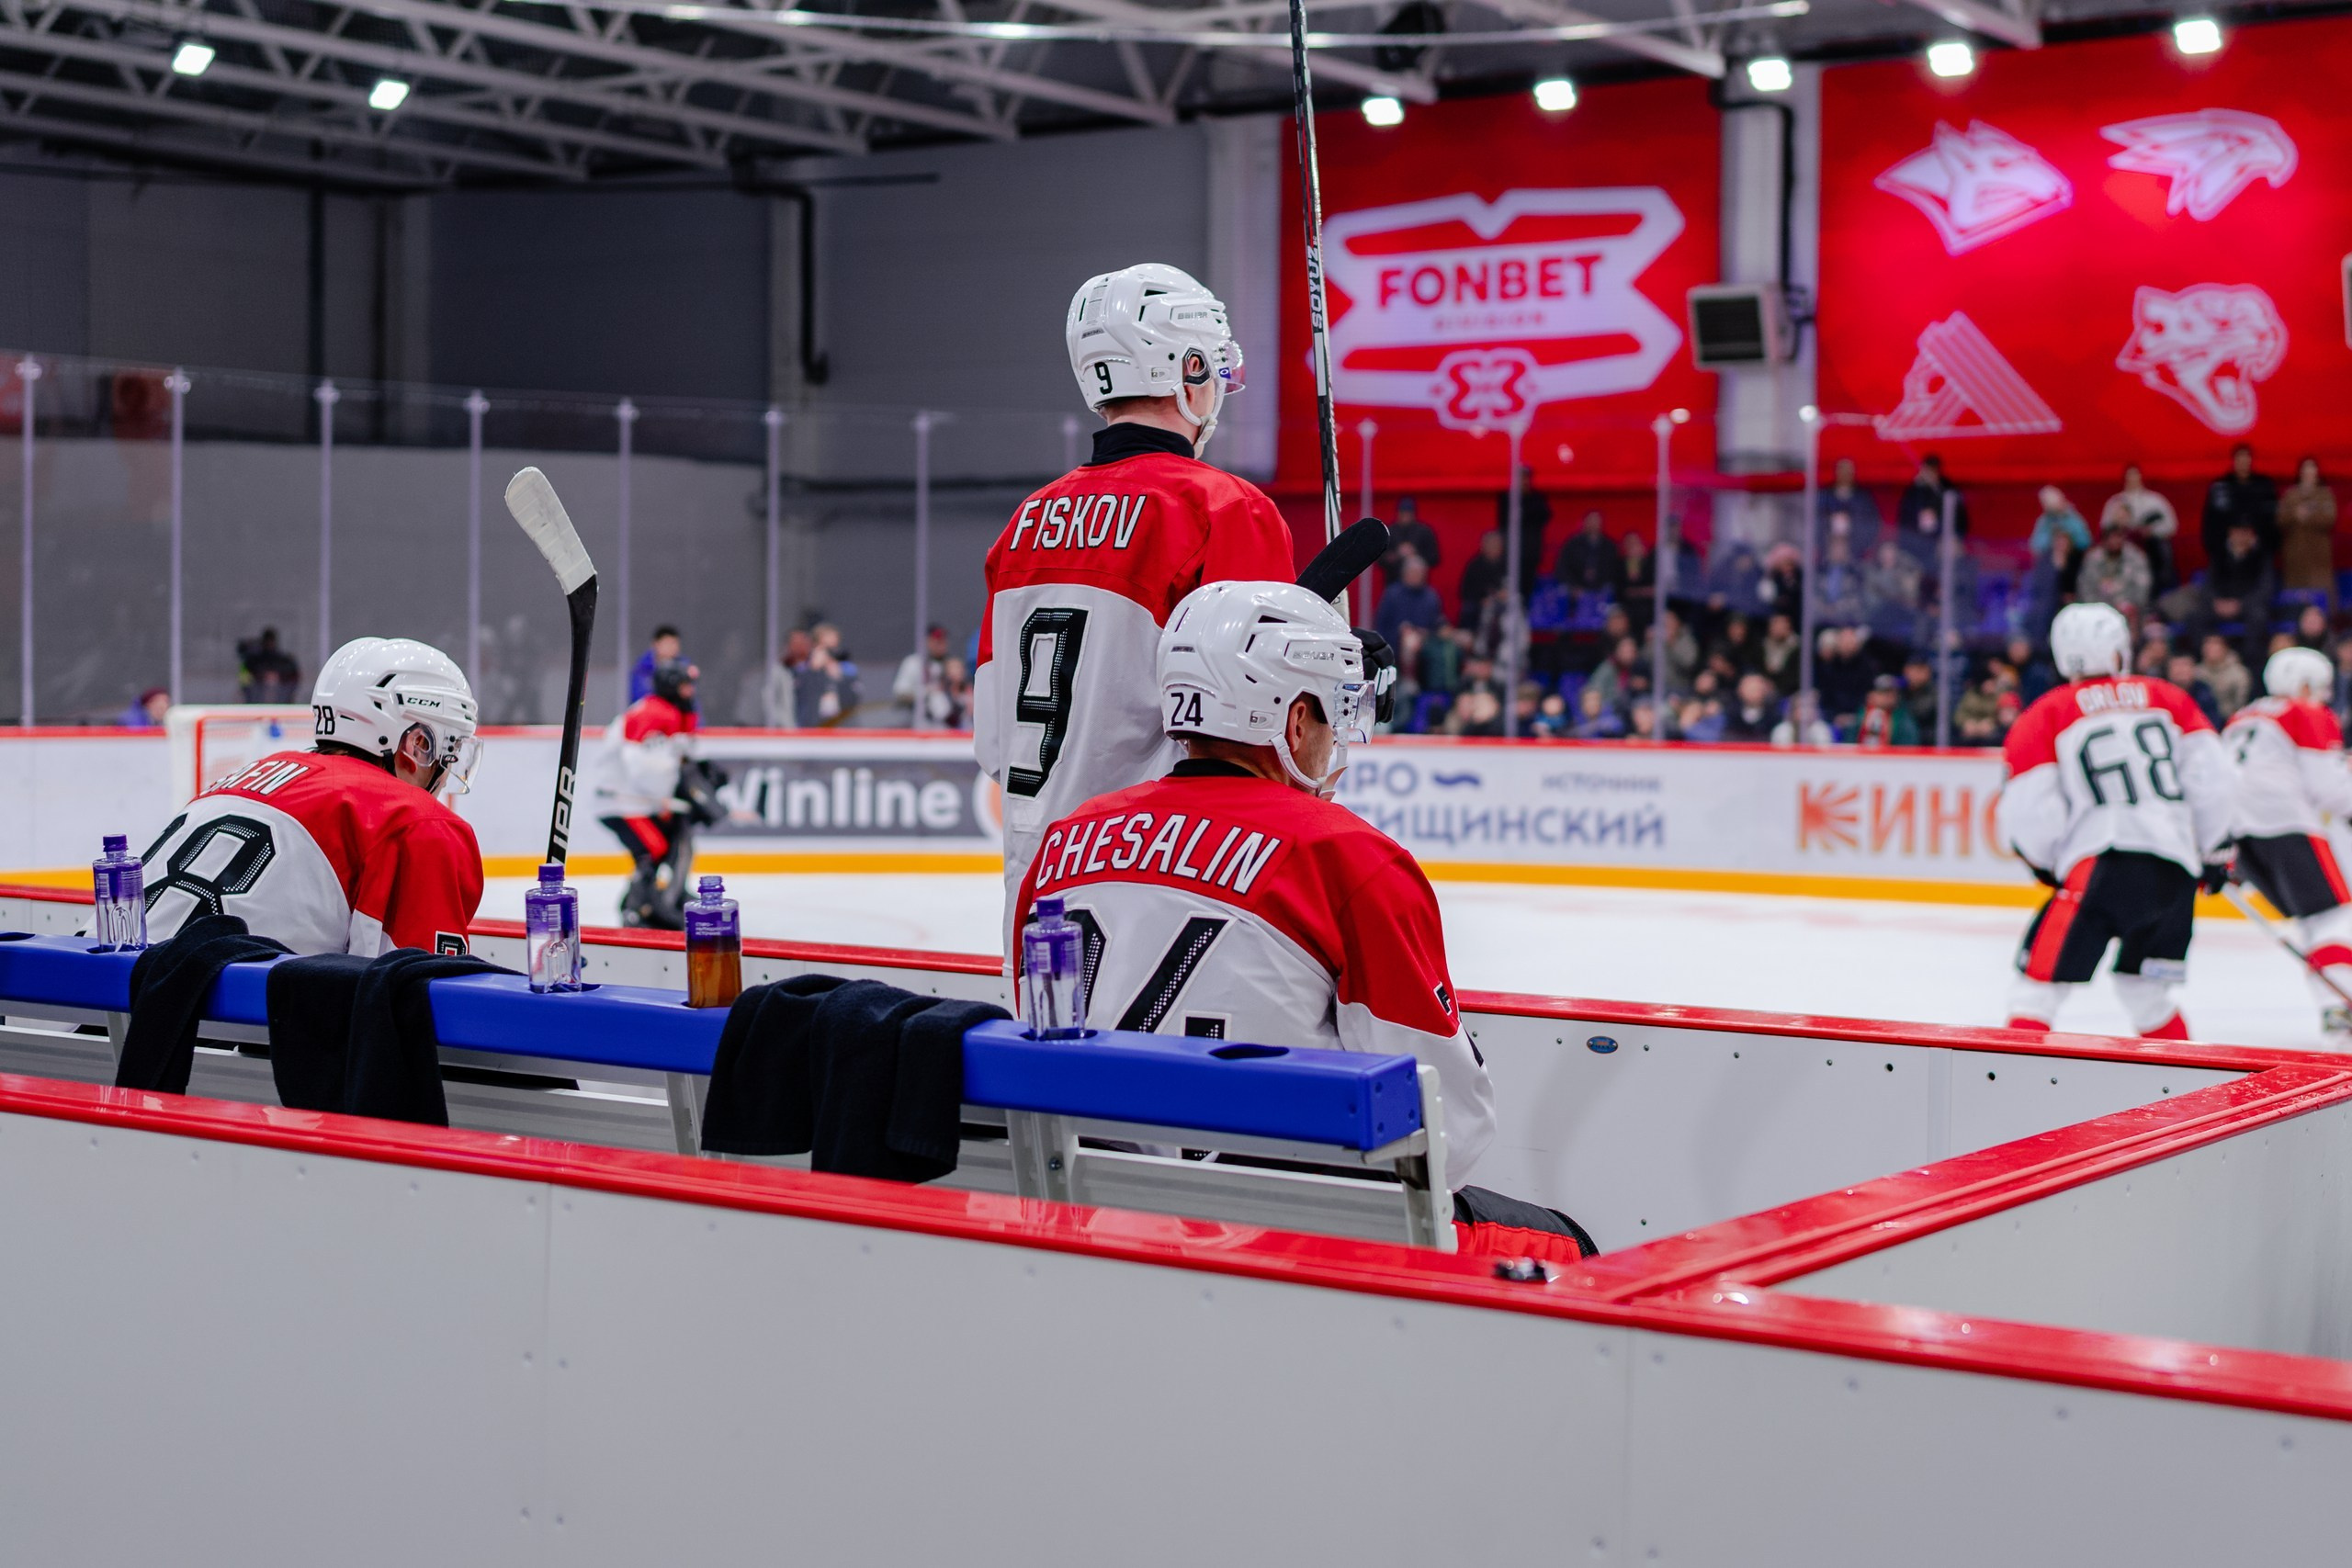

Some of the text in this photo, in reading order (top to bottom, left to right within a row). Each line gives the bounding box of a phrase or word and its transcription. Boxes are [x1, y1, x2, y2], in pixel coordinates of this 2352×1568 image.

[1307, 244, 1323, 329] SOYUZ
[1378, 251, 1602, 310] FONBET
[1094, 361, 1113, 395] 9
[1010, 494, 1148, 551] FISKOV
[312, 705, 335, 735] 28
[407, 697, 441, 708] CCM
[1006, 607, 1090, 798] 9
[1170, 692, 1204, 727] 24
[2079, 721, 2184, 805] 68
[1035, 812, 1282, 895] CHESALIN
